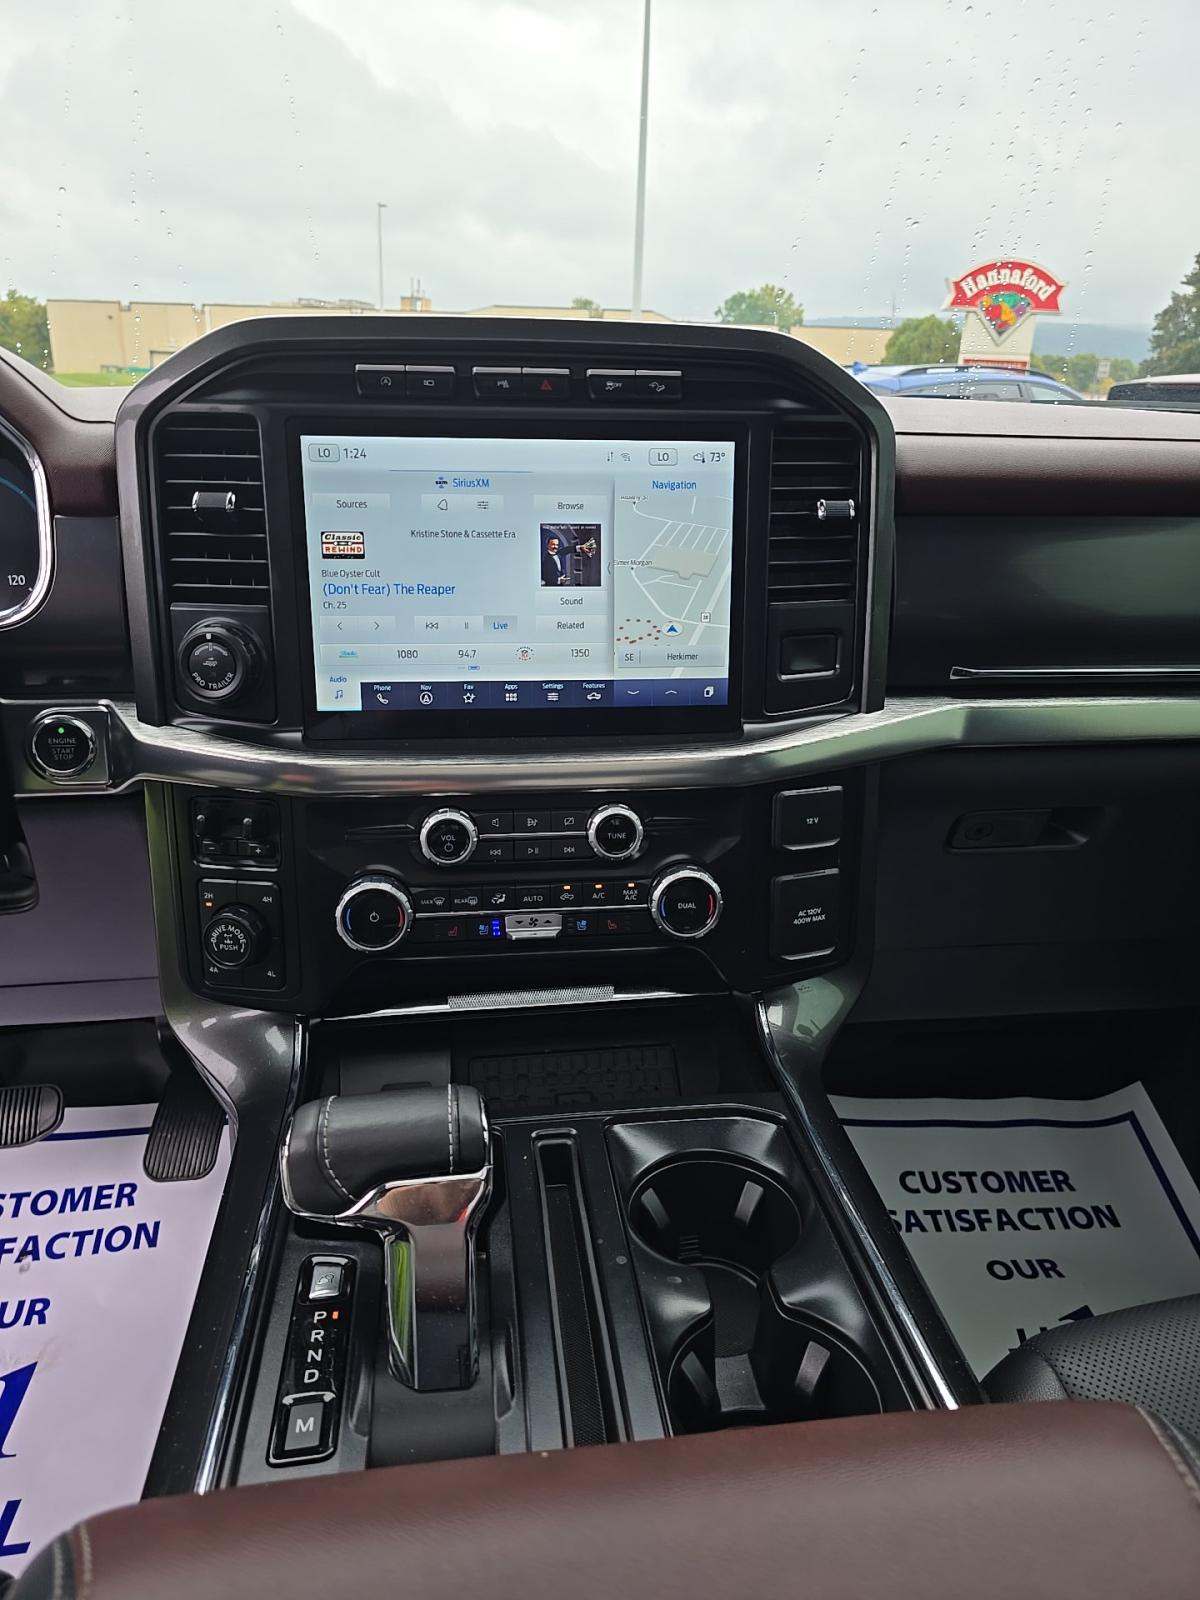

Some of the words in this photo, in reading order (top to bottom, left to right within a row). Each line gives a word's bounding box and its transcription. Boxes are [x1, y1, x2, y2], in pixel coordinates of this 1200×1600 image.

[960, 268, 1056, 302] Hannaford
[318, 448, 331, 458] LO
[343, 448, 367, 459] 1:24
[657, 453, 669, 462] LO
[452, 478, 490, 488] SiriusXM
[652, 480, 697, 491] Navigation
[336, 500, 368, 509] Sources
[557, 502, 584, 510] Browse
[410, 530, 439, 538] Kristine
[464, 531, 470, 539] &
[471, 531, 503, 539] Cassette
[504, 531, 516, 539] Era
[8, 575, 26, 585] 120
[321, 570, 338, 578] Blue
[340, 570, 365, 580] Oyster
[365, 570, 381, 578] Cult
[323, 583, 359, 597] (Don't
[362, 584, 391, 597] Fear)
[394, 584, 414, 595] The
[417, 584, 456, 597] Reaper
[560, 598, 583, 606] Sound
[493, 621, 509, 630] Live
[557, 622, 585, 630] Related
[397, 650, 418, 659] 1080
[458, 650, 477, 659] 94.7
[571, 649, 590, 658] 1350
[625, 654, 634, 662] SE
[667, 653, 698, 661] Herkimer
[192, 672, 206, 687] PRO
[208, 672, 234, 690] TRAILER
[504, 684, 518, 692] Apps
[542, 683, 564, 691] Settings
[807, 907, 822, 915] 120V
[793, 917, 811, 925] 400W
[812, 914, 826, 922] MAX
[211, 925, 227, 943] DRIVE
[228, 925, 246, 944] MODE
[899, 1170, 1076, 1194] CUSTOMER
[986, 1259, 1065, 1281] OUR
[313, 1311, 327, 1323] P
[311, 1330, 324, 1342] R
[307, 1349, 322, 1362] N
[304, 1369, 319, 1383] D
[295, 1417, 314, 1433] M
